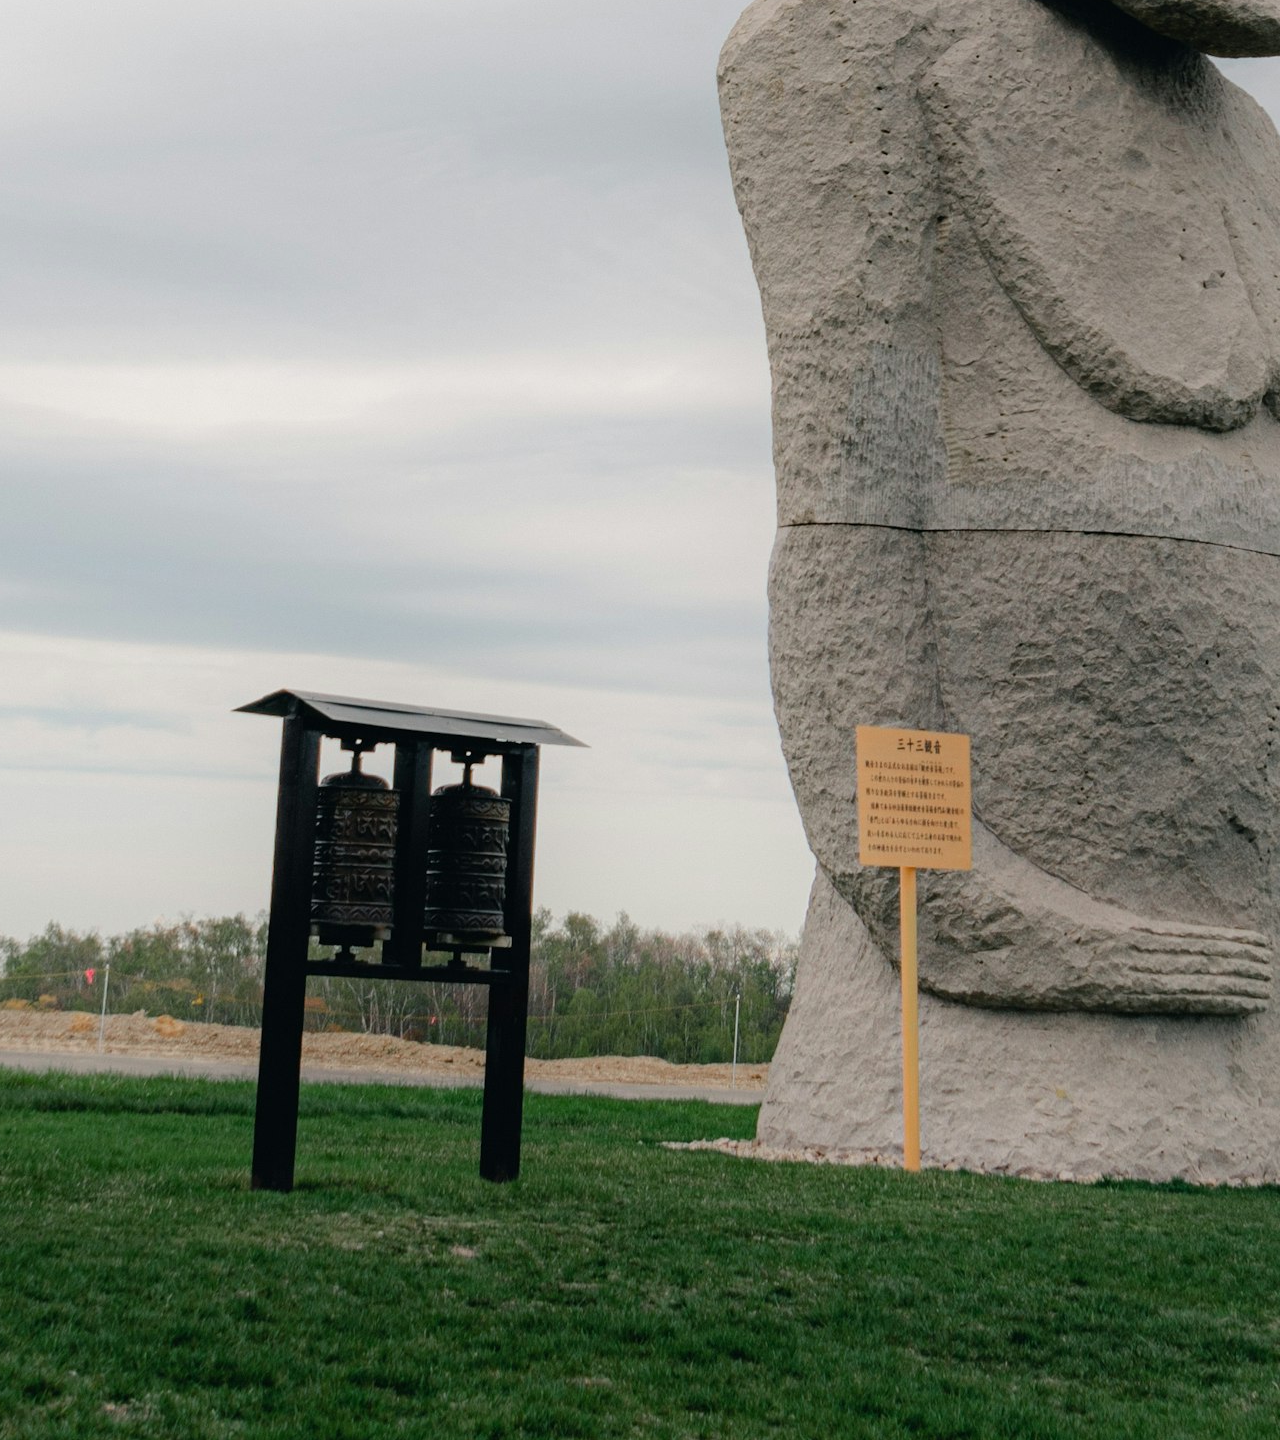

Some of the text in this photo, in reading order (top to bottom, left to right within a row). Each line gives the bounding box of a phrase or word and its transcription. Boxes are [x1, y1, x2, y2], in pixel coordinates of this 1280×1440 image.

[897, 738, 941, 754] 三十三観音
